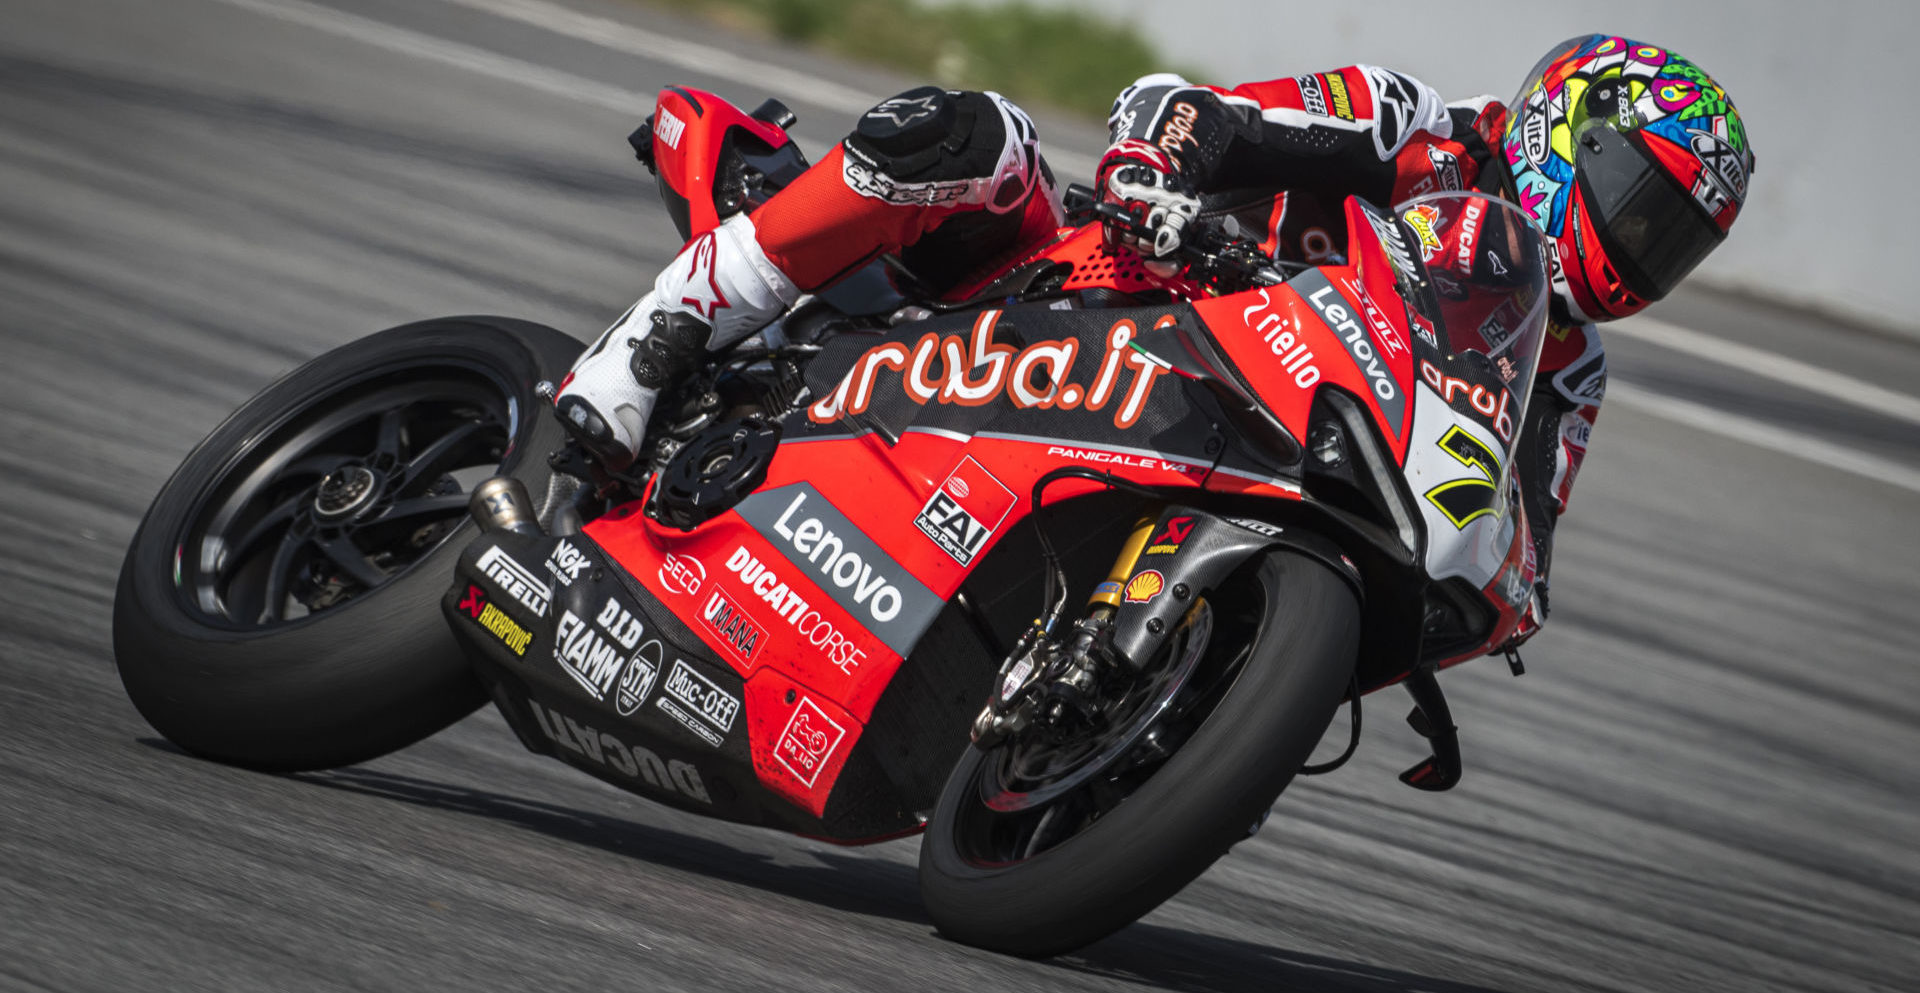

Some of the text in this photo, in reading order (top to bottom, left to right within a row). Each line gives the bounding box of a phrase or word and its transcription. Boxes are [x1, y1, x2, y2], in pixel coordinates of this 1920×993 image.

[1527, 99, 1546, 157] X-lite
[1617, 85, 1631, 128] X-803
[1698, 138, 1744, 195] X-lite
[1458, 204, 1481, 276] DUCATI
[1308, 286, 1395, 401] Lenovo
[1351, 278, 1402, 352] STULZ
[1256, 310, 1321, 389] riello
[1048, 447, 1157, 469] PANIGALE
[1423, 423, 1506, 531] 7
[917, 516, 968, 563] Auto Parts
[924, 491, 987, 552] FAI
[475, 545, 552, 617] PIRELLI
[550, 538, 592, 579] NGK
[662, 553, 701, 596] SECO
[773, 492, 902, 622] Lenovo
[556, 609, 625, 694] FIAMM
[703, 592, 760, 658] UMANA
[622, 658, 656, 700] STM
[669, 666, 737, 727] Muc-Off
[663, 702, 688, 722] SPEED
[530, 700, 713, 804] DUCATI
